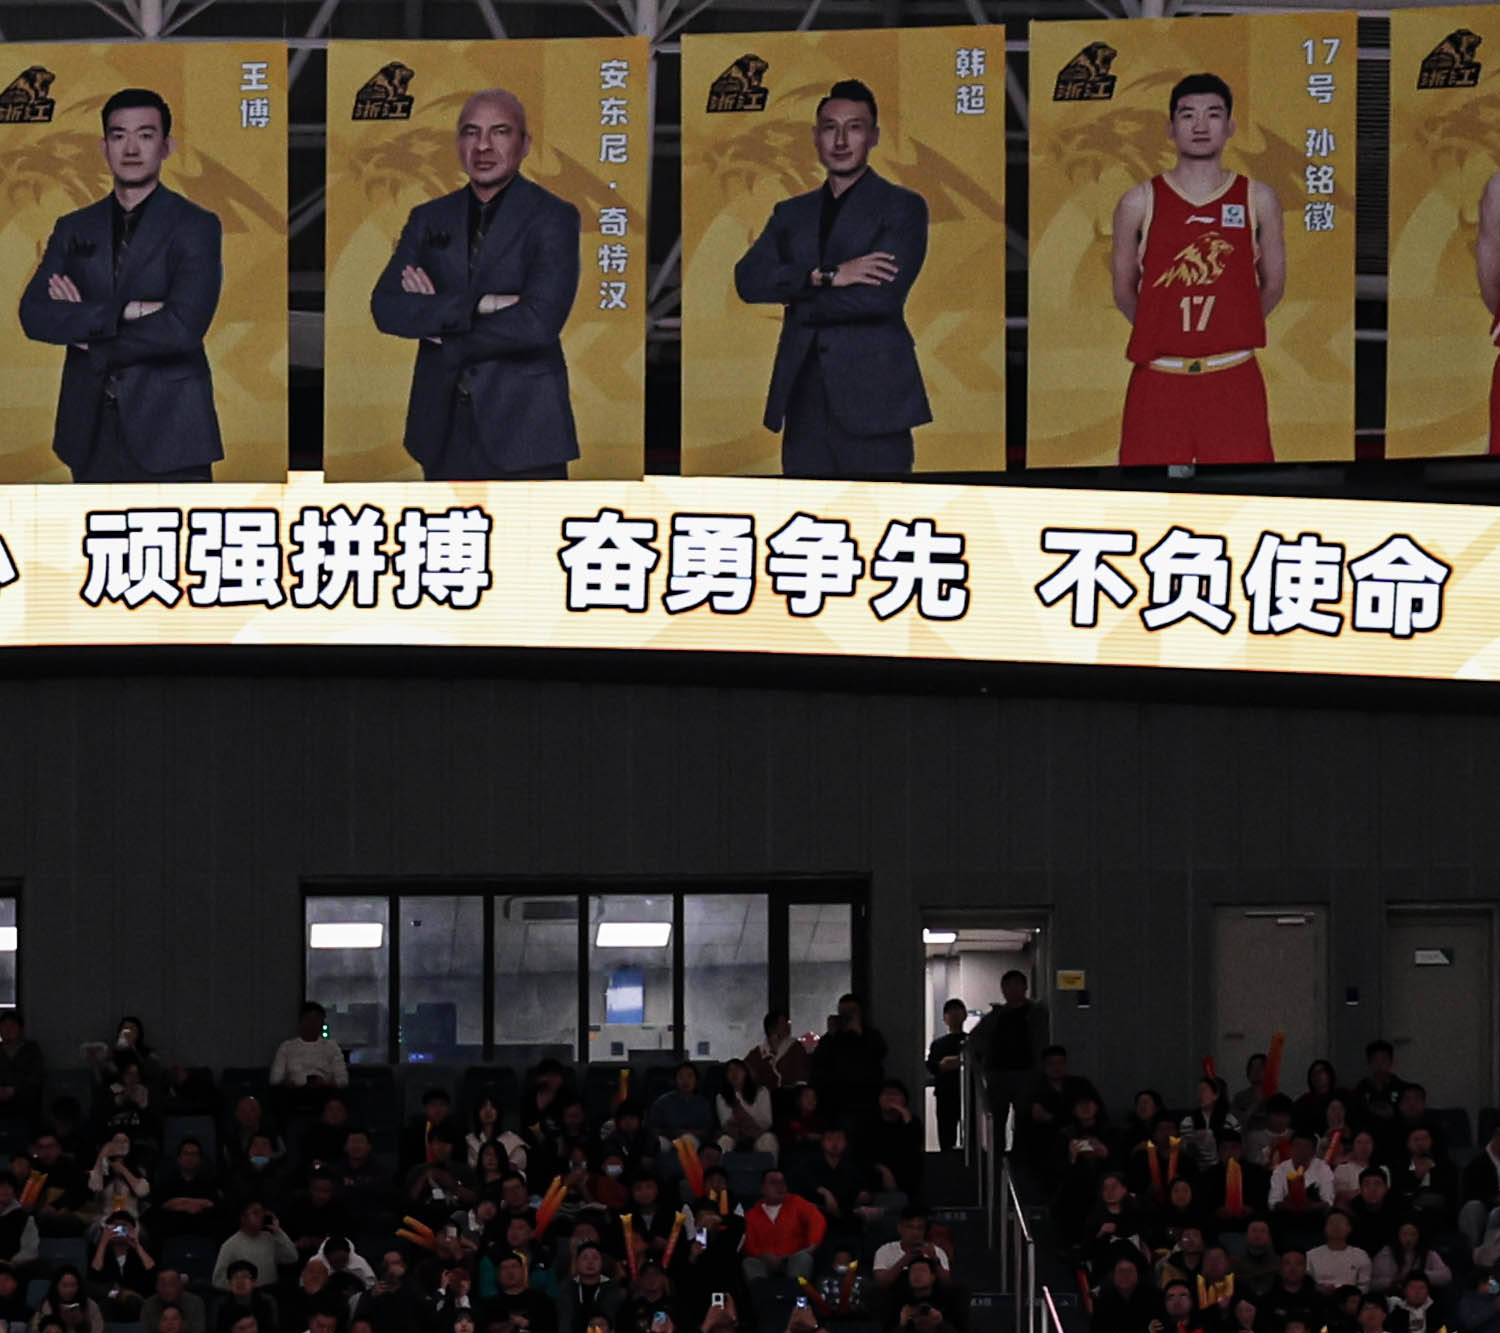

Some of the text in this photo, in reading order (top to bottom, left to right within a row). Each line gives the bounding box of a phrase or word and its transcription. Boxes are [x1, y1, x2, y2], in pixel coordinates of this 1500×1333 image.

[239, 62, 270, 128] 王博
[955, 48, 986, 114] 韩超
[1302, 38, 1341, 232] 17号 孙铭徽
[598, 60, 630, 309] 安东尼·奇特汉
[1180, 296, 1216, 331] 17
[83, 508, 492, 608] 顽强拼搏
[559, 507, 969, 621] 奋勇争先
[1036, 524, 1452, 637] 不负使命
